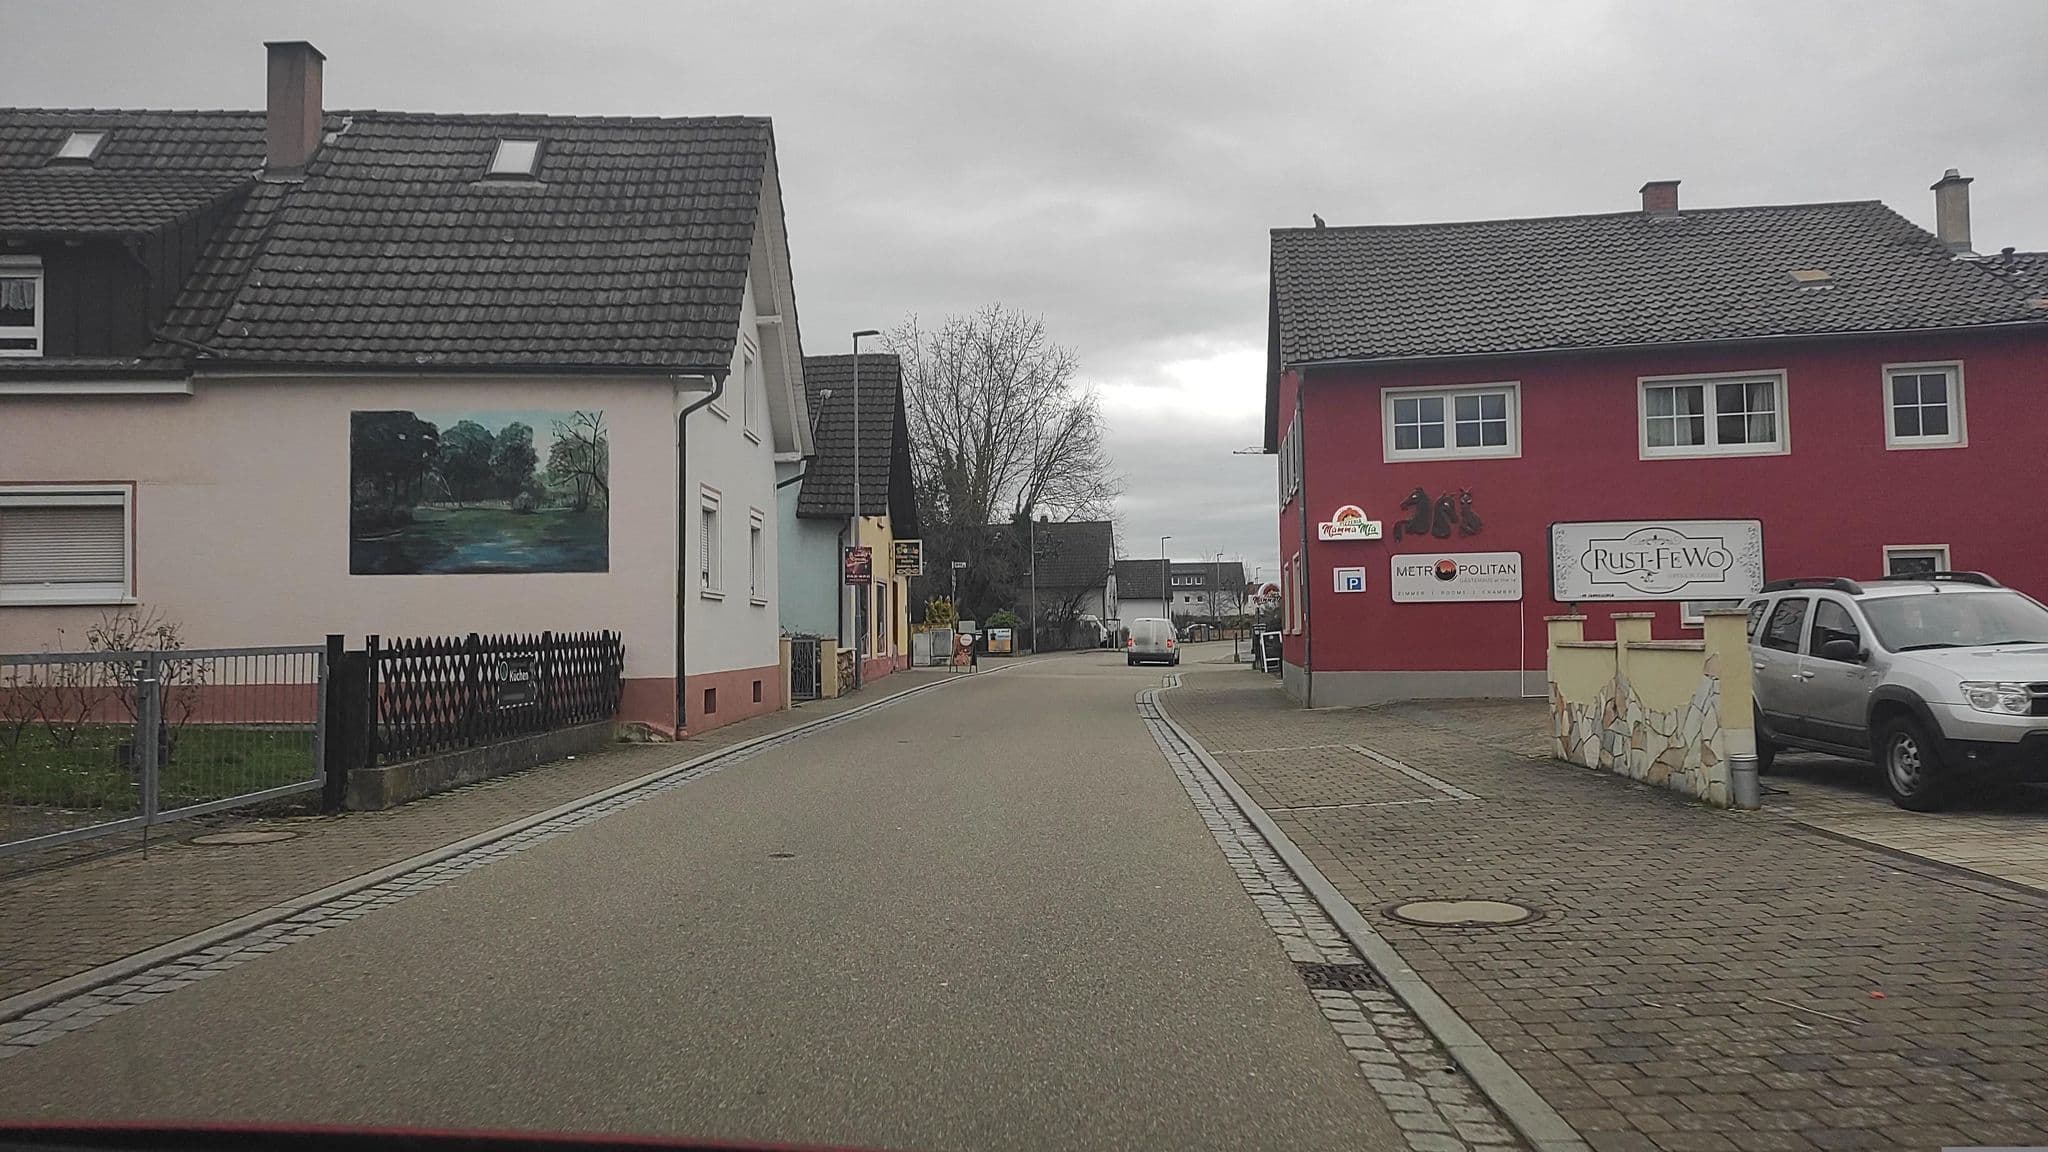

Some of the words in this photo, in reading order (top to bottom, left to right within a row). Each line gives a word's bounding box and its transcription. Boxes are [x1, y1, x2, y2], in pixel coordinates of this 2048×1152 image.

[1322, 523, 1357, 538] Mamma
[1358, 522, 1379, 537] Mia
[1349, 578, 1360, 590] P
